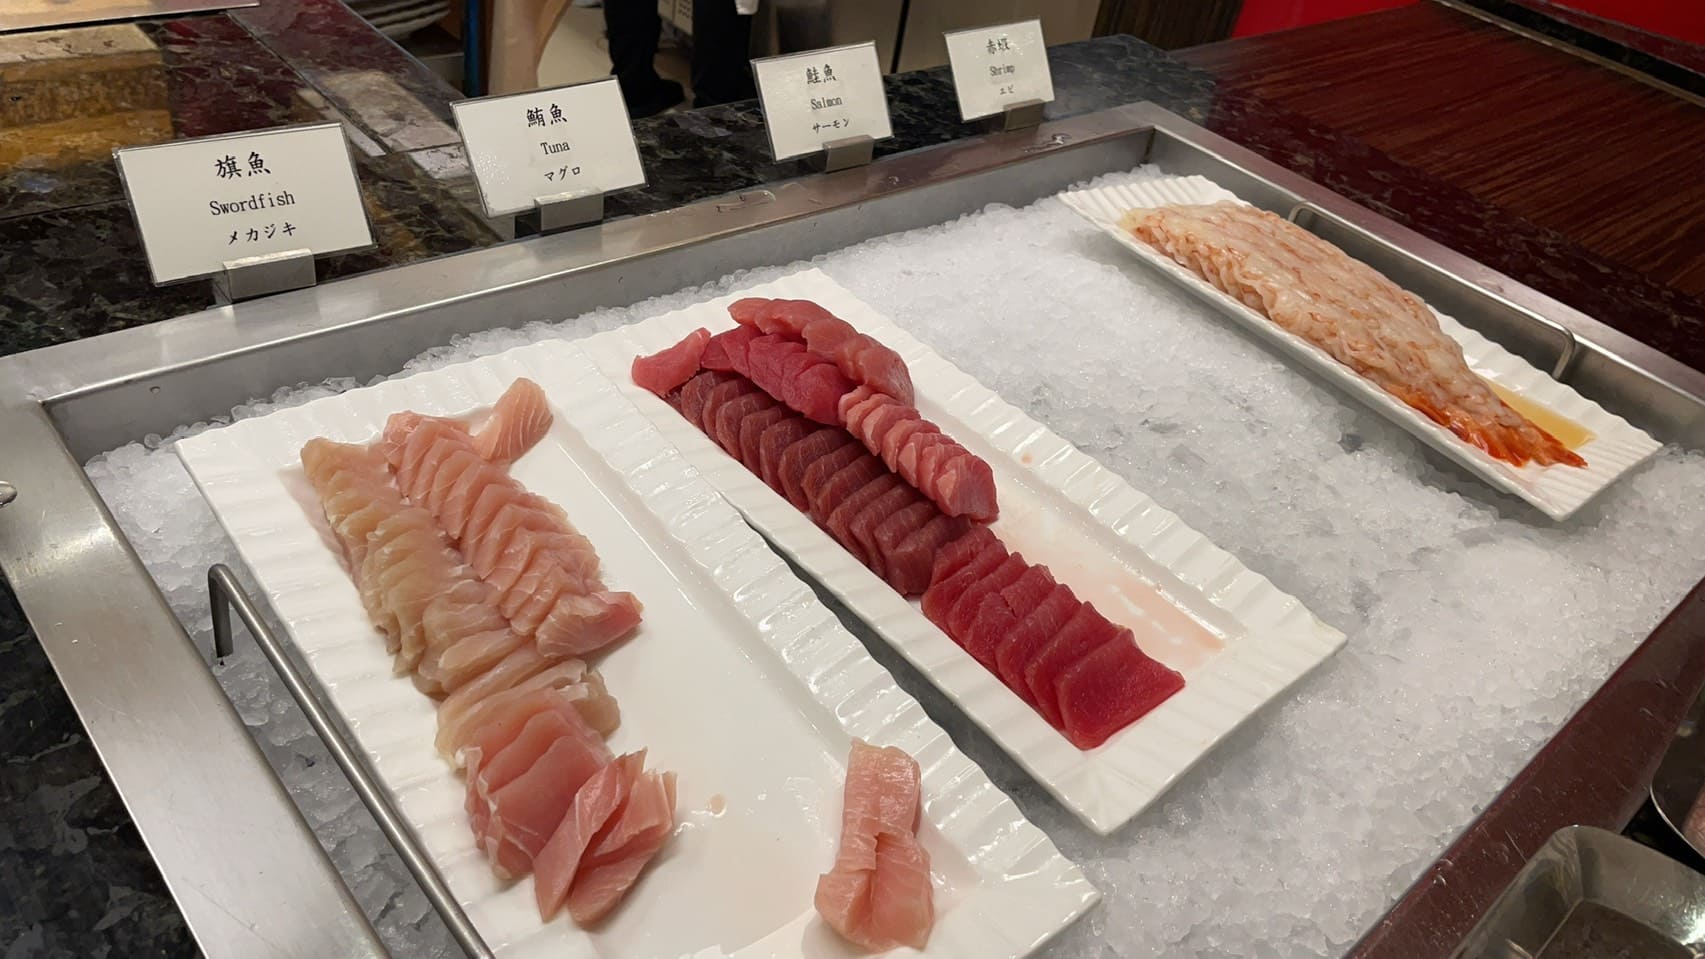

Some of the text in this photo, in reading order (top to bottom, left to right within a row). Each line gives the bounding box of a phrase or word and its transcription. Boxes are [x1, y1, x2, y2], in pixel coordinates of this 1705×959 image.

[806, 63, 837, 84] 鮭魚
[989, 64, 1016, 77] Shrimp
[999, 84, 1015, 95] エビ
[810, 96, 843, 110] Salmon
[526, 103, 568, 128] 鮪魚
[812, 118, 850, 134] サーモン
[540, 141, 570, 156] Tuna
[214, 151, 271, 180] 旗魚
[544, 165, 582, 182] マグロ
[209, 190, 296, 216] Swordfish
[228, 221, 297, 246] メカジキ
